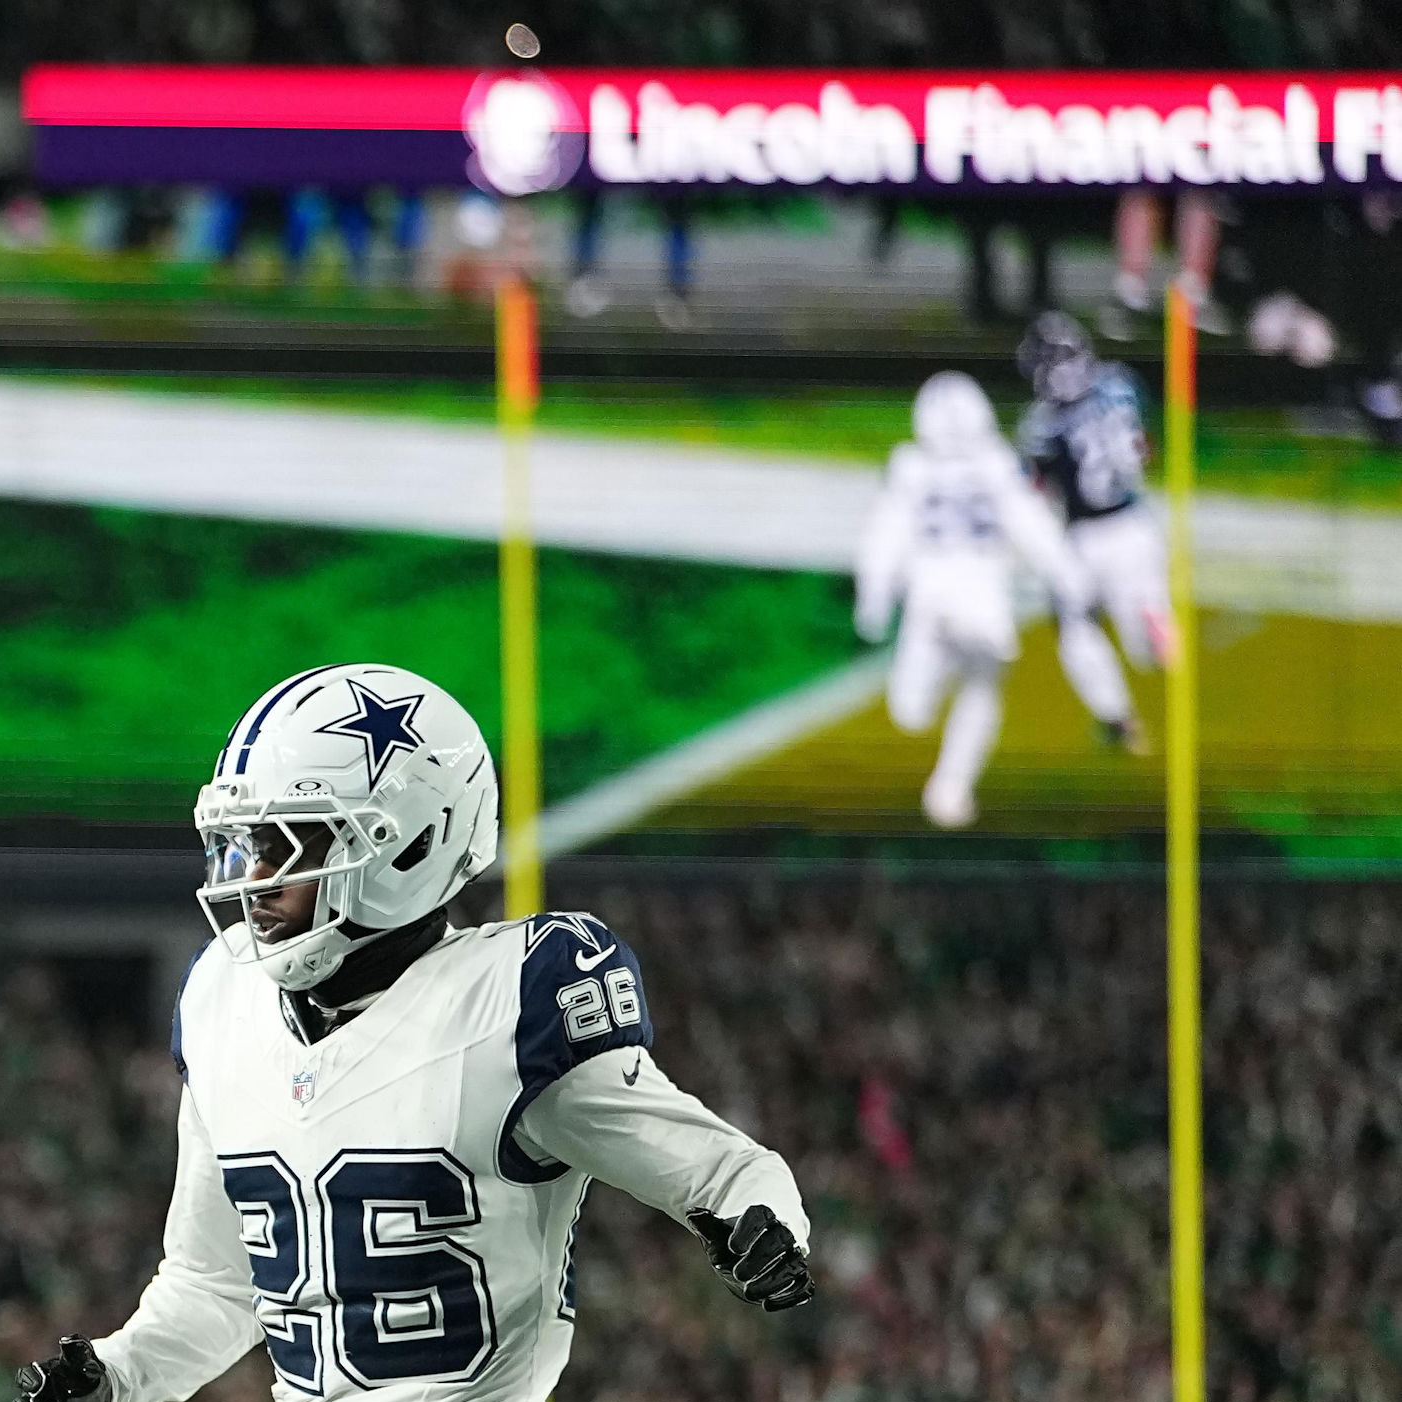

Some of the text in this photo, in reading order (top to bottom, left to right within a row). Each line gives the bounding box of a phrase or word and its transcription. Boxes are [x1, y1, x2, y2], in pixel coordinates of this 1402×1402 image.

[589, 80, 917, 184] Lincoln
[924, 83, 1324, 185] Financial
[556, 967, 641, 1043] 26
[294, 1084, 310, 1100] NFL
[217, 1147, 498, 1397] 26
